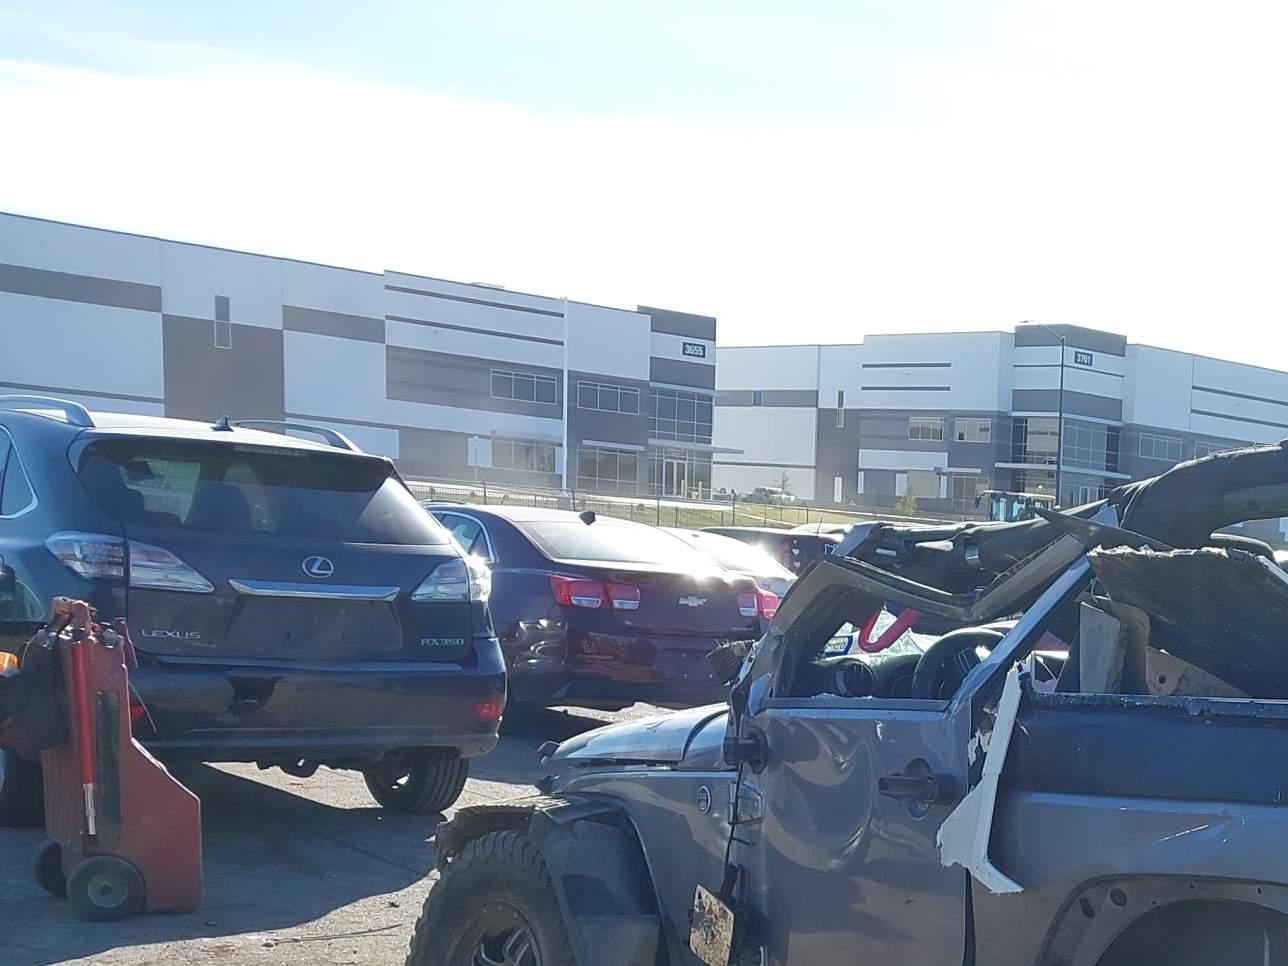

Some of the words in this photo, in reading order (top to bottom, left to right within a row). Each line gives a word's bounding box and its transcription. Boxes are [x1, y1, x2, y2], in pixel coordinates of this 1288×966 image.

[684, 344, 704, 356] 3655
[1076, 353, 1092, 365] 3701
[142, 629, 201, 639] LEXUS
